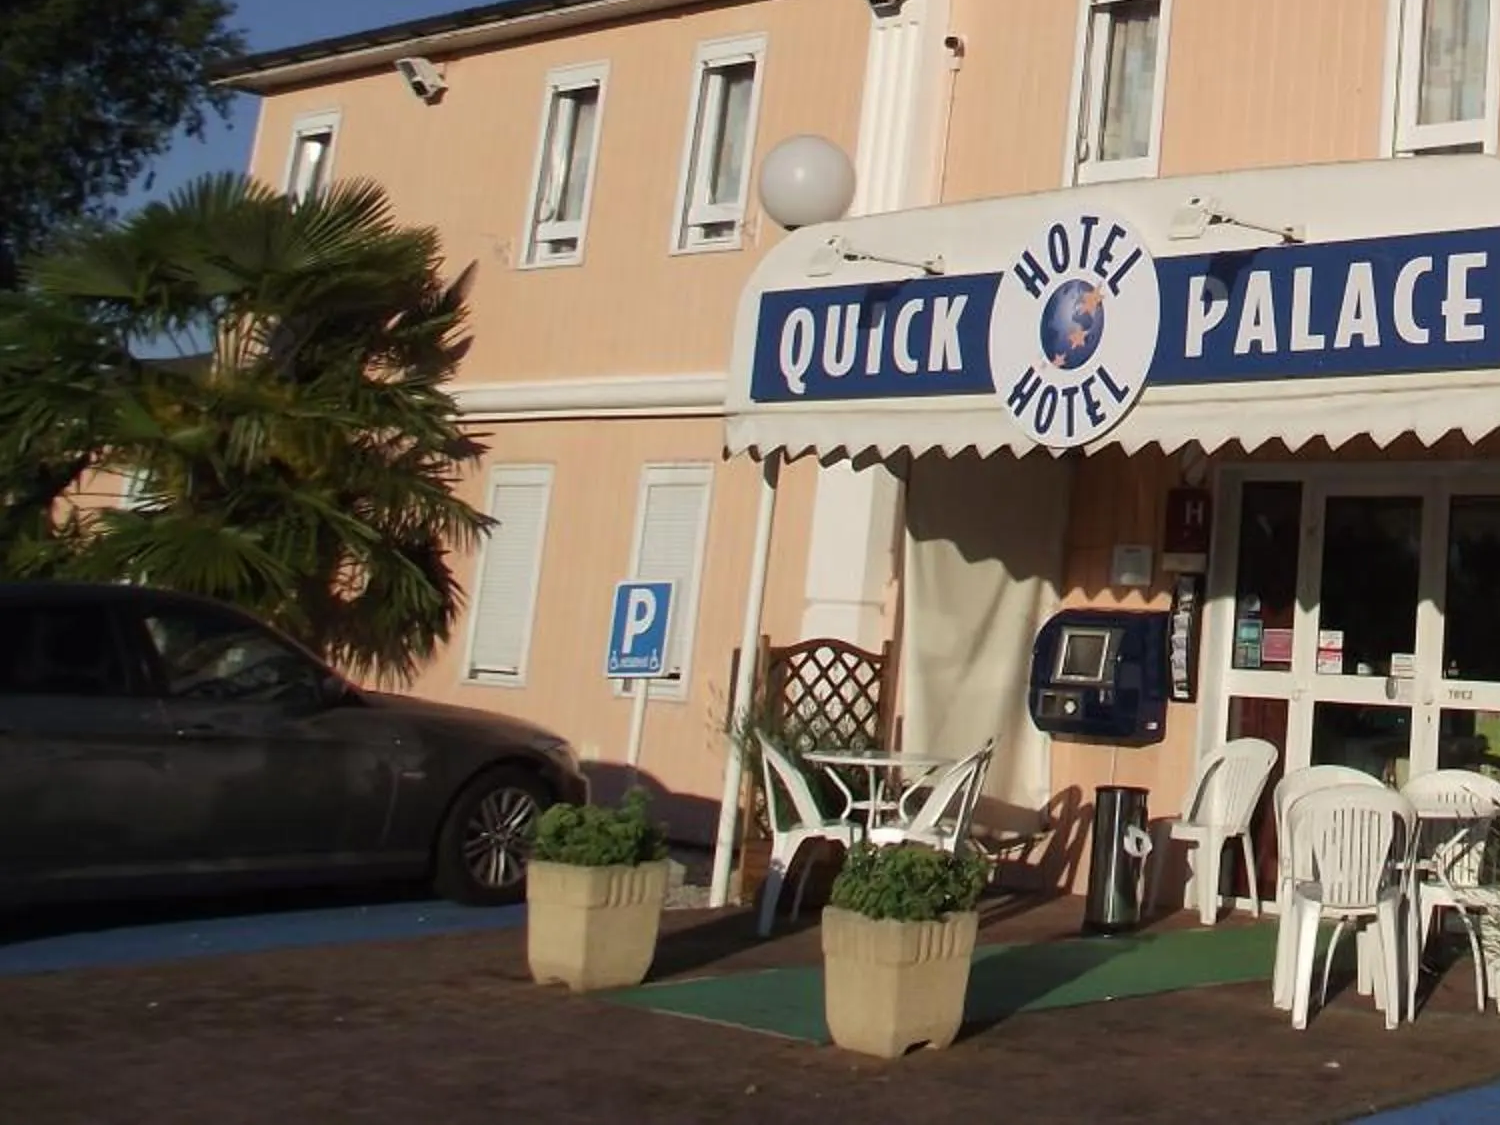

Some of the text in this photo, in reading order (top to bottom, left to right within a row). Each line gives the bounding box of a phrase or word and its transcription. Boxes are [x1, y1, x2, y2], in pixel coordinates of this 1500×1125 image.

[1013, 215, 1143, 300] HOTEL
[779, 251, 1489, 395] QUICK PALACE
[1007, 364, 1130, 438] HOTEL
[1184, 500, 1205, 526] H
[621, 587, 657, 655] P
